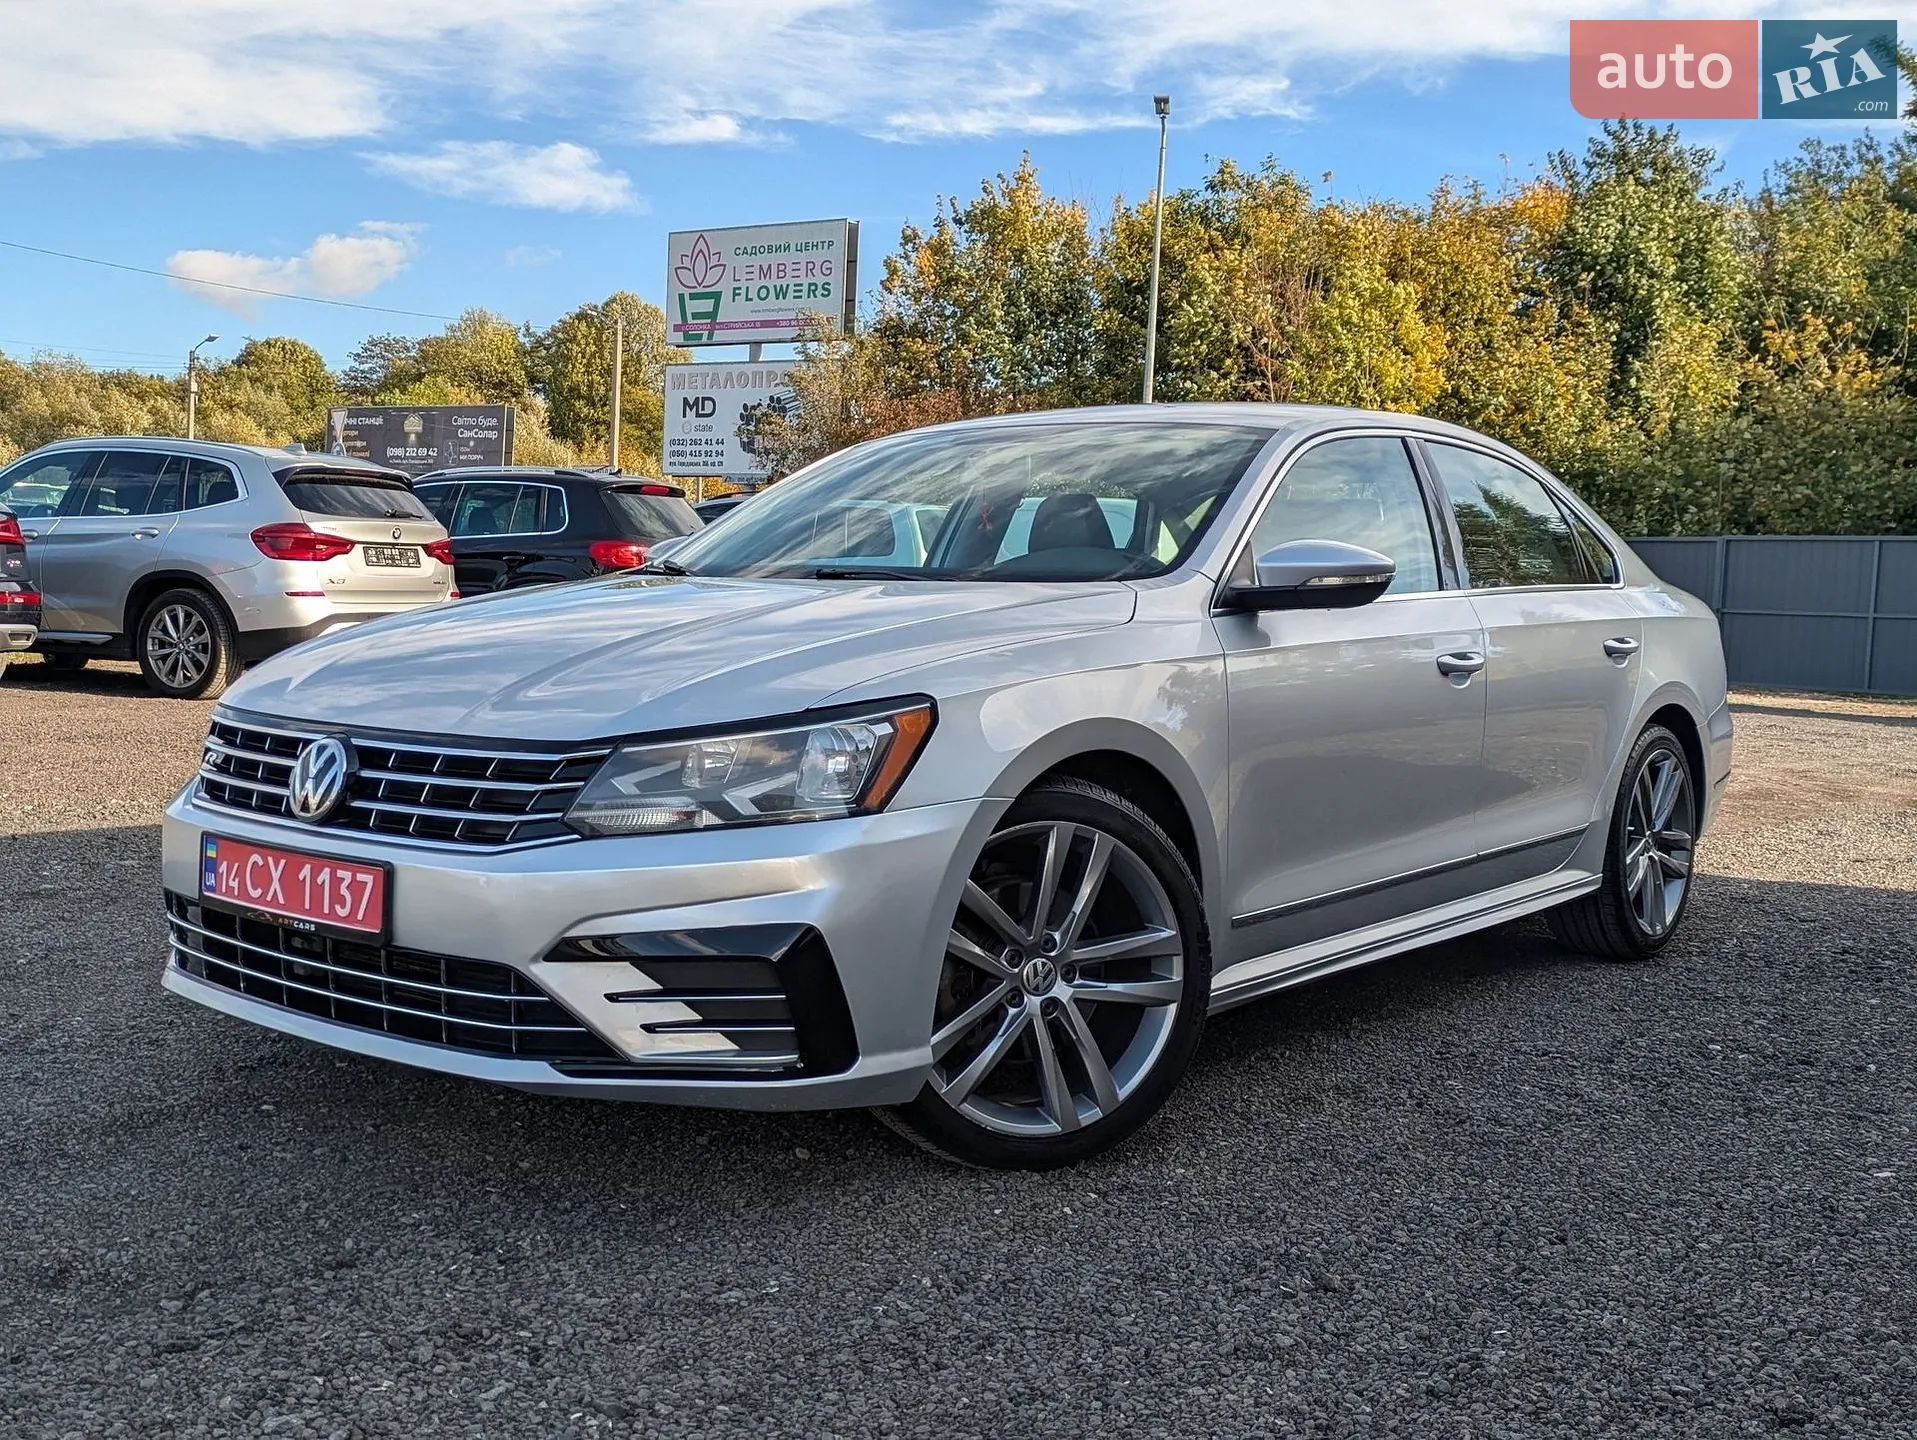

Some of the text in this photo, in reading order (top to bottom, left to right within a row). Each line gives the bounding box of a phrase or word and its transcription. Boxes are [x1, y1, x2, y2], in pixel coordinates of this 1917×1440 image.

[734, 240, 835, 257] САДОВИЙ ЦЕНТР
[732, 259, 833, 282] LEMBERG
[732, 281, 832, 303] FLOWERS
[452, 415, 499, 428] Світло буде.
[693, 423, 714, 433] state
[457, 428, 499, 440] СанСолар
[669, 438, 725, 447] (032) 262 41 44
[386, 446, 438, 458] (098) 212 69 42
[669, 449, 725, 459] (050) 415 92 94
[205, 871, 216, 887] UA
[219, 853, 374, 921] 14 CX 1137
